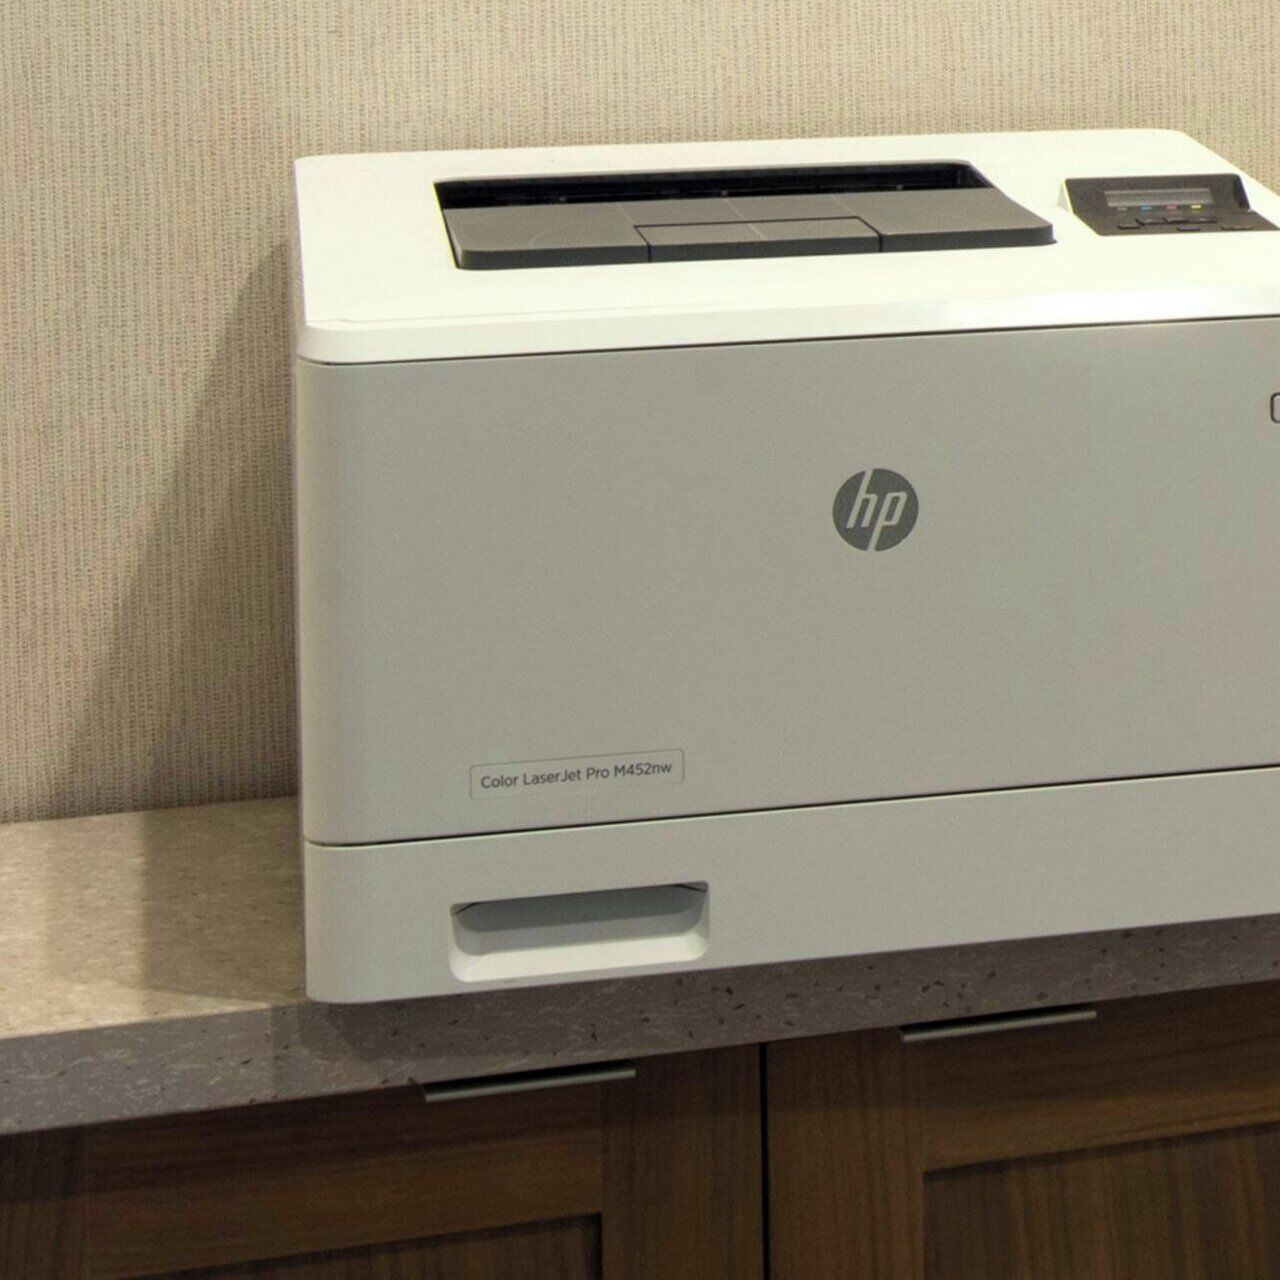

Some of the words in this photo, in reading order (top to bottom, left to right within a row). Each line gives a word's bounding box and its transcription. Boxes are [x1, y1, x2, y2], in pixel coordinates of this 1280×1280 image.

[845, 468, 908, 552] hp
[480, 774, 519, 789] Color
[523, 768, 581, 785] LaserJet
[585, 767, 610, 780] Pro
[613, 762, 673, 777] M452nw
